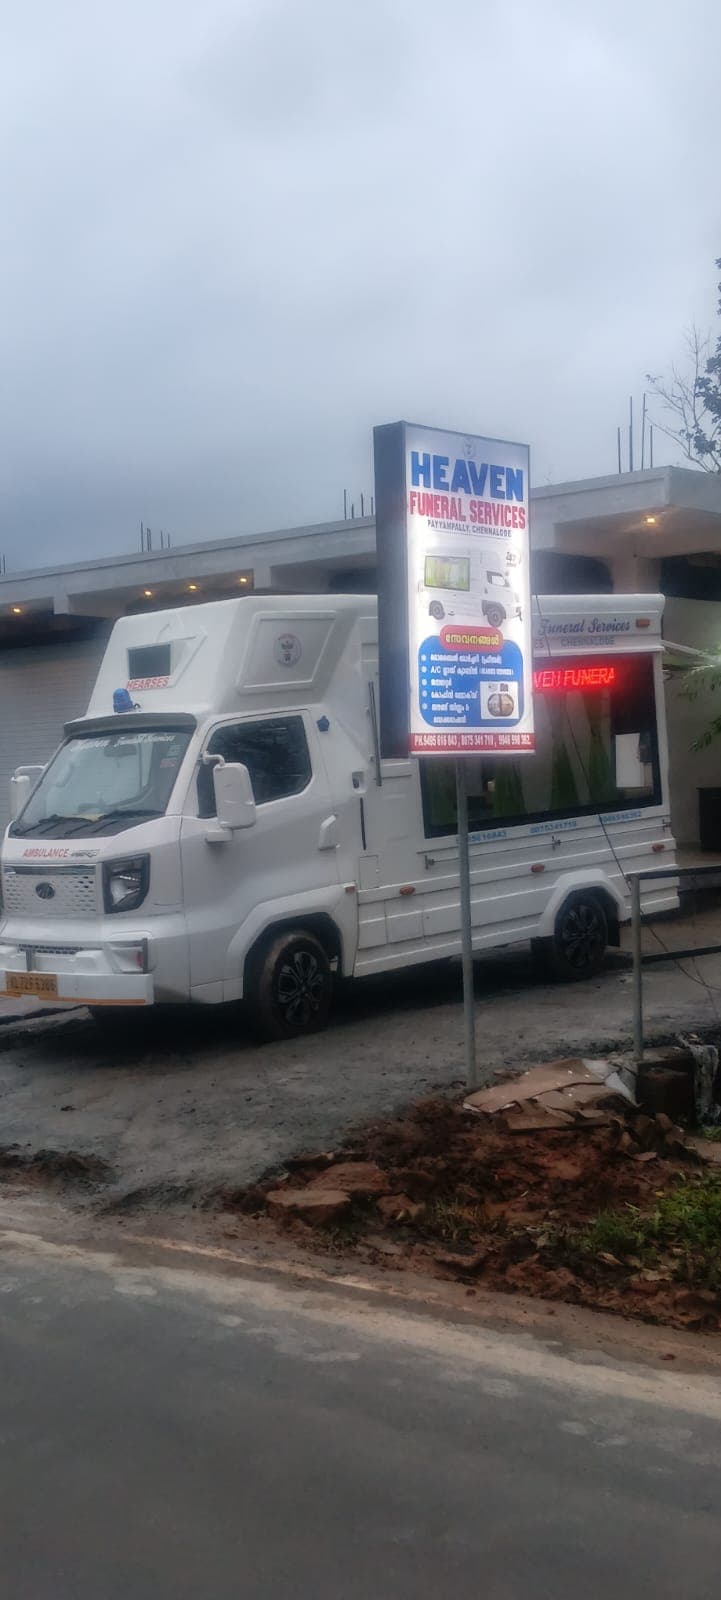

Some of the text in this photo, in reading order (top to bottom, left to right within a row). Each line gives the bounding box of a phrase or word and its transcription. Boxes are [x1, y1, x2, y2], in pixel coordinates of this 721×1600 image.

[411, 451, 524, 502] HEAVEN
[410, 491, 526, 529] FUNERAL SERVICES
[538, 617, 631, 636] Funeral Services
[126, 677, 170, 690] HEARSES
[564, 667, 616, 686] FUNERA
[23, 848, 70, 858] AMBULANCE
